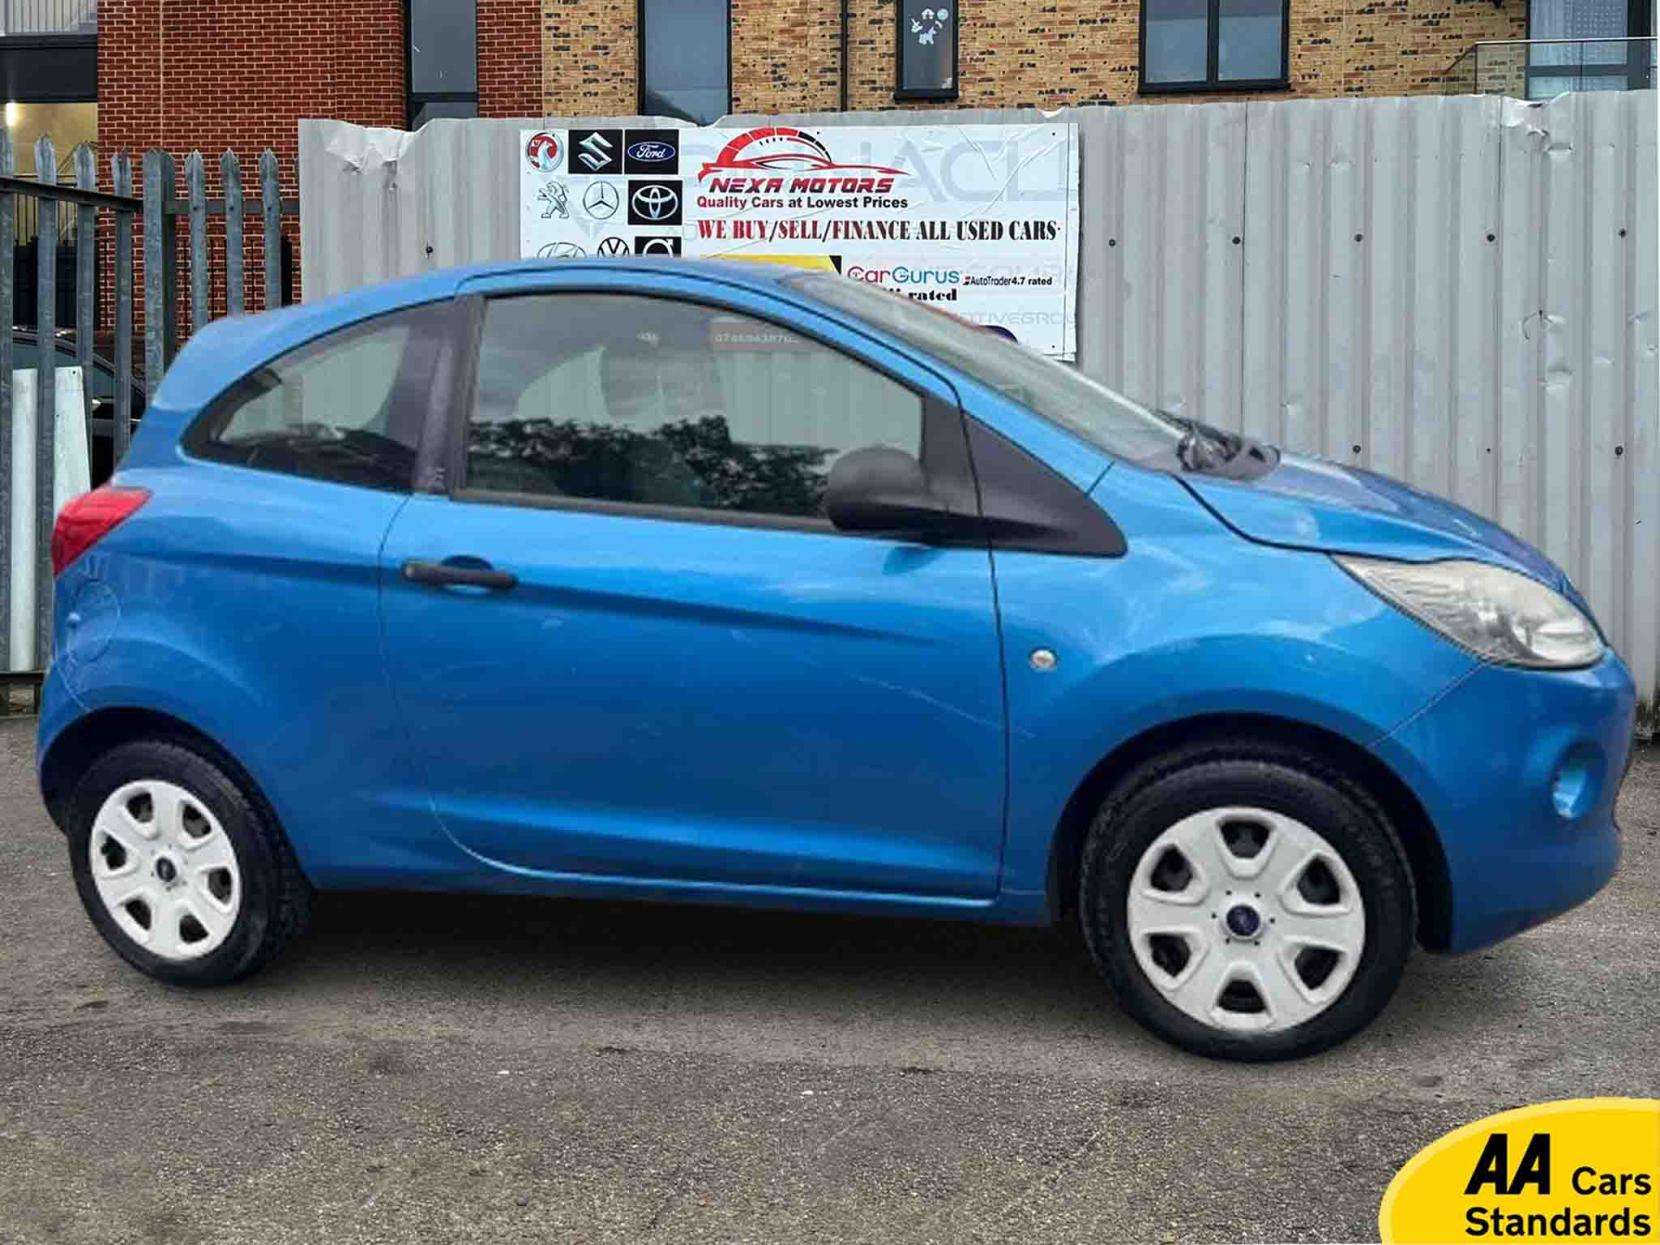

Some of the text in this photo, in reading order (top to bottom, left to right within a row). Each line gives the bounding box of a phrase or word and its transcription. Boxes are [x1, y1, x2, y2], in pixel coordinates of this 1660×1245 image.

[636, 145, 667, 159] Ford
[708, 178, 895, 194] NEXA MOTORS
[697, 195, 909, 209] Quality Cars at Lowest Prices
[699, 220, 726, 239] WE
[916, 221, 950, 241] ALL
[957, 221, 1004, 241] USED
[1008, 220, 1057, 241] CARS
[846, 265, 960, 285] CarGurus
[1028, 276, 1053, 286] rated
[907, 288, 958, 301] rated
